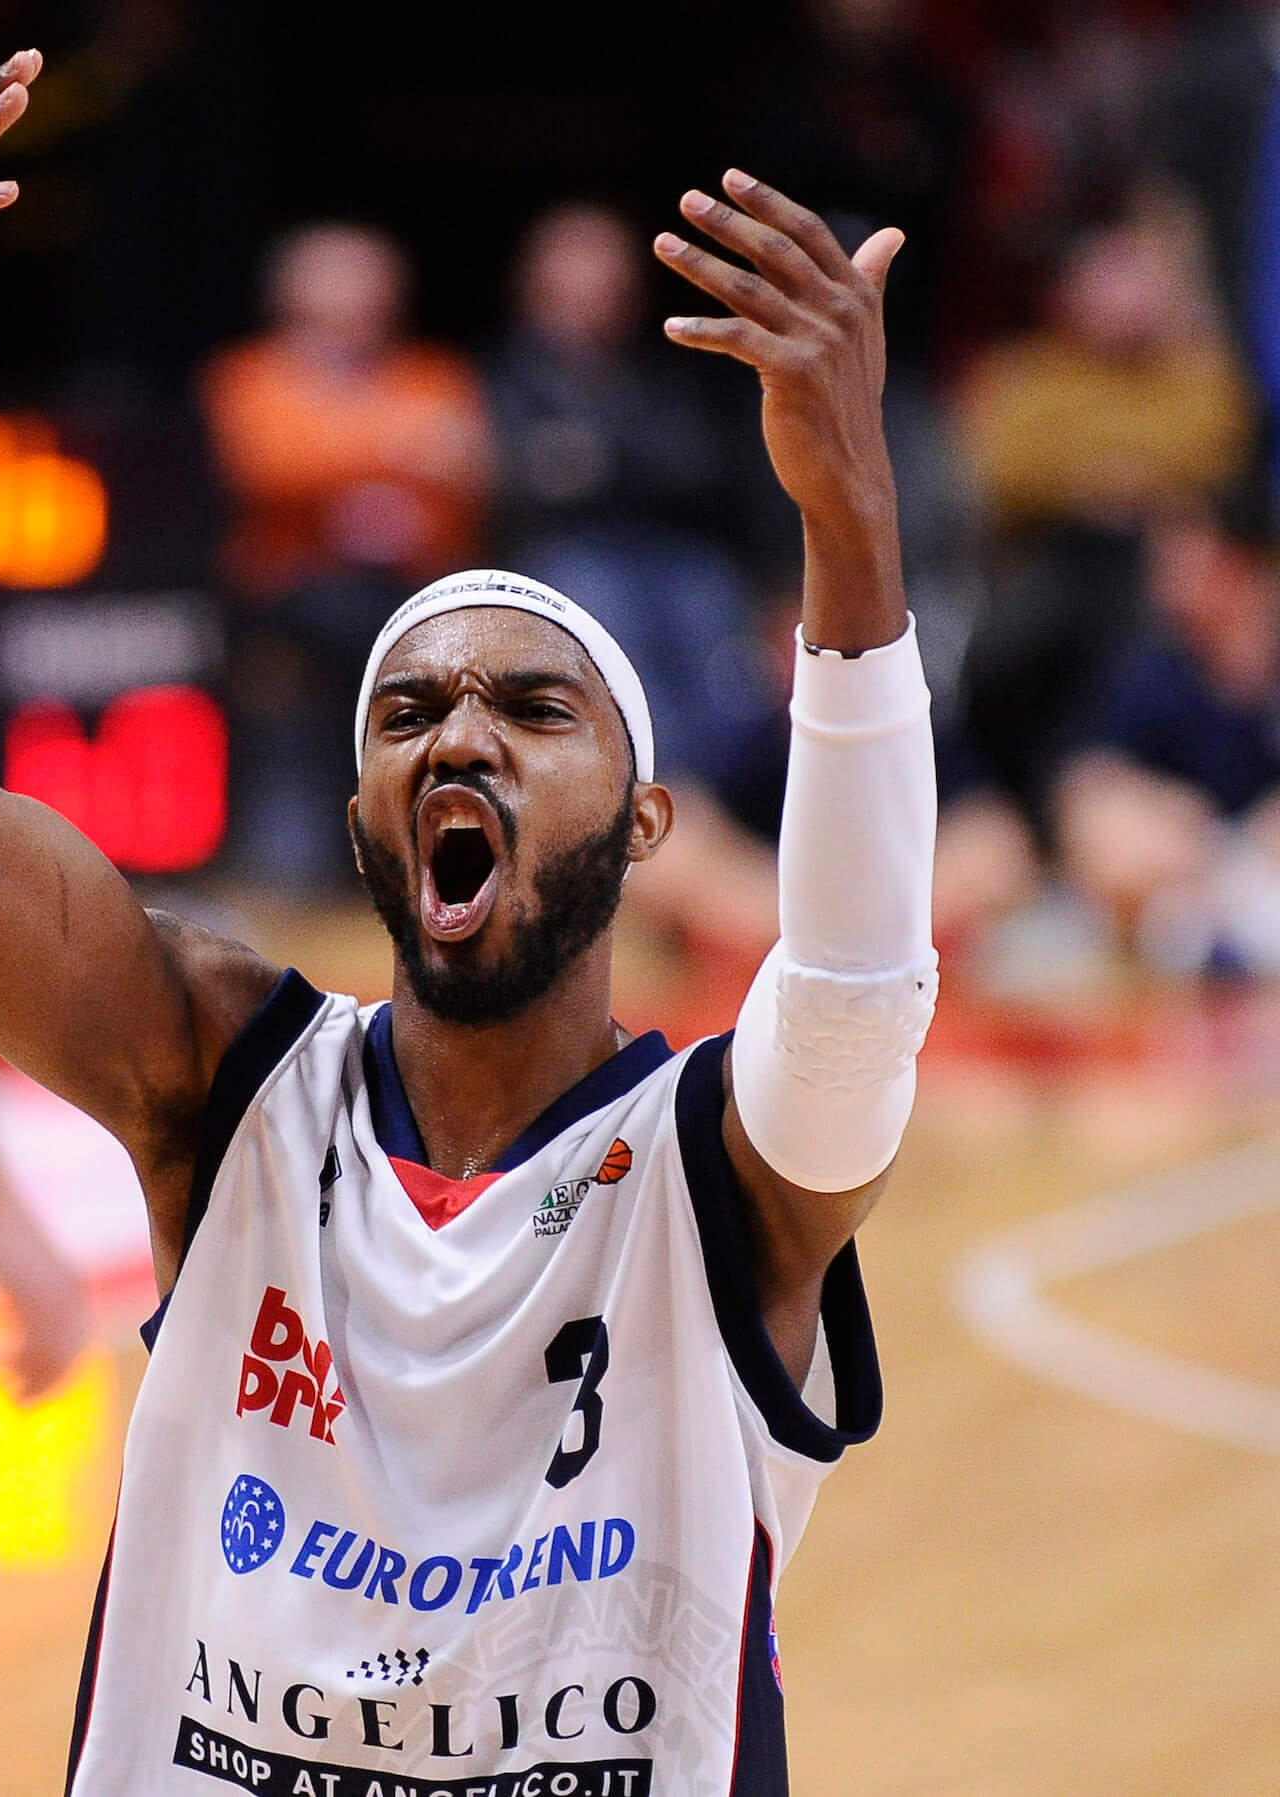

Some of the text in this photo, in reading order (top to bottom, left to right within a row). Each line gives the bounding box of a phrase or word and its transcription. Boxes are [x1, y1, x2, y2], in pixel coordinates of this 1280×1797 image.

[544, 1315, 610, 1489] 3
[289, 1517, 636, 1615] EUROTREND
[185, 1638, 657, 1757] ANGELICO
[189, 1731, 272, 1787] SHOP
[292, 1769, 342, 1797] AT
